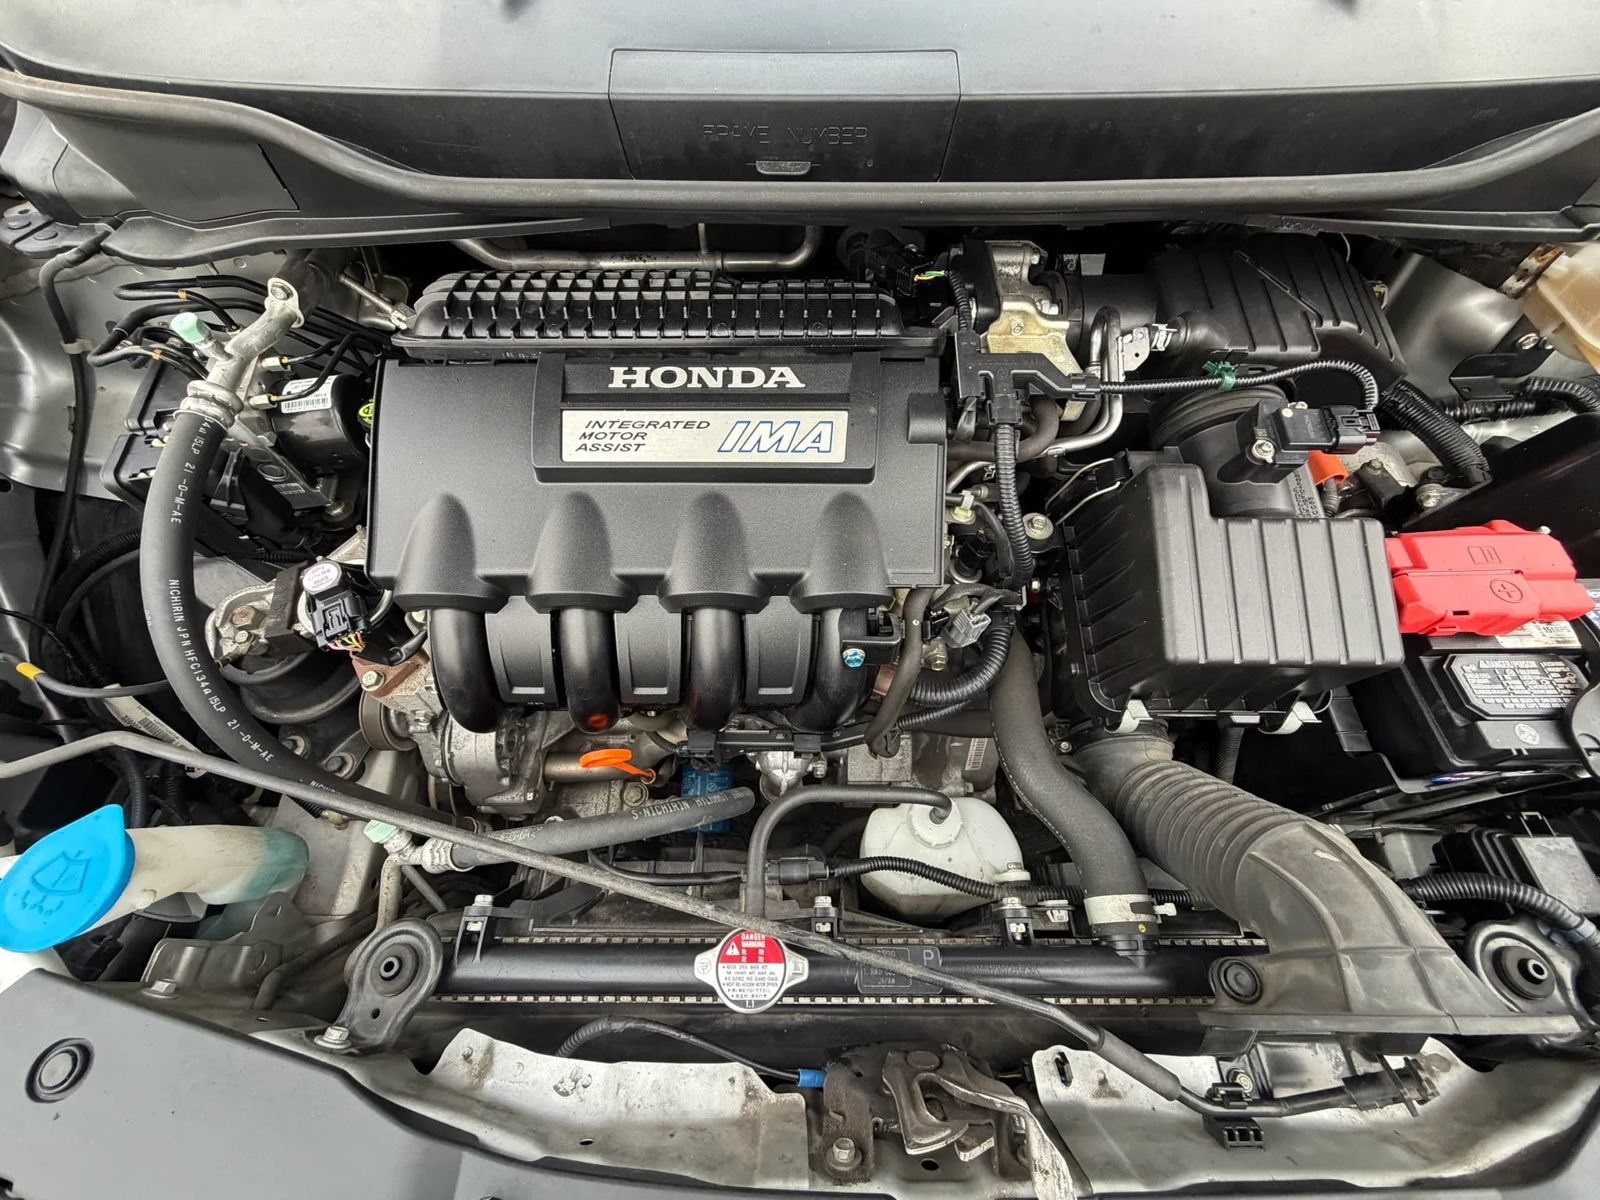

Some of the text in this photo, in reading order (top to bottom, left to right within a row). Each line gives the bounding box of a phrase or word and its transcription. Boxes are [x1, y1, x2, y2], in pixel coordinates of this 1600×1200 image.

[608, 366, 806, 389] HONDA
[584, 420, 711, 430] INTEGRATED
[578, 431, 648, 441] MOTOR
[717, 420, 834, 453] IMA
[575, 443, 646, 452] ASSIST
[169, 579, 185, 622] NICHIRIN
[176, 626, 192, 647] JPN
